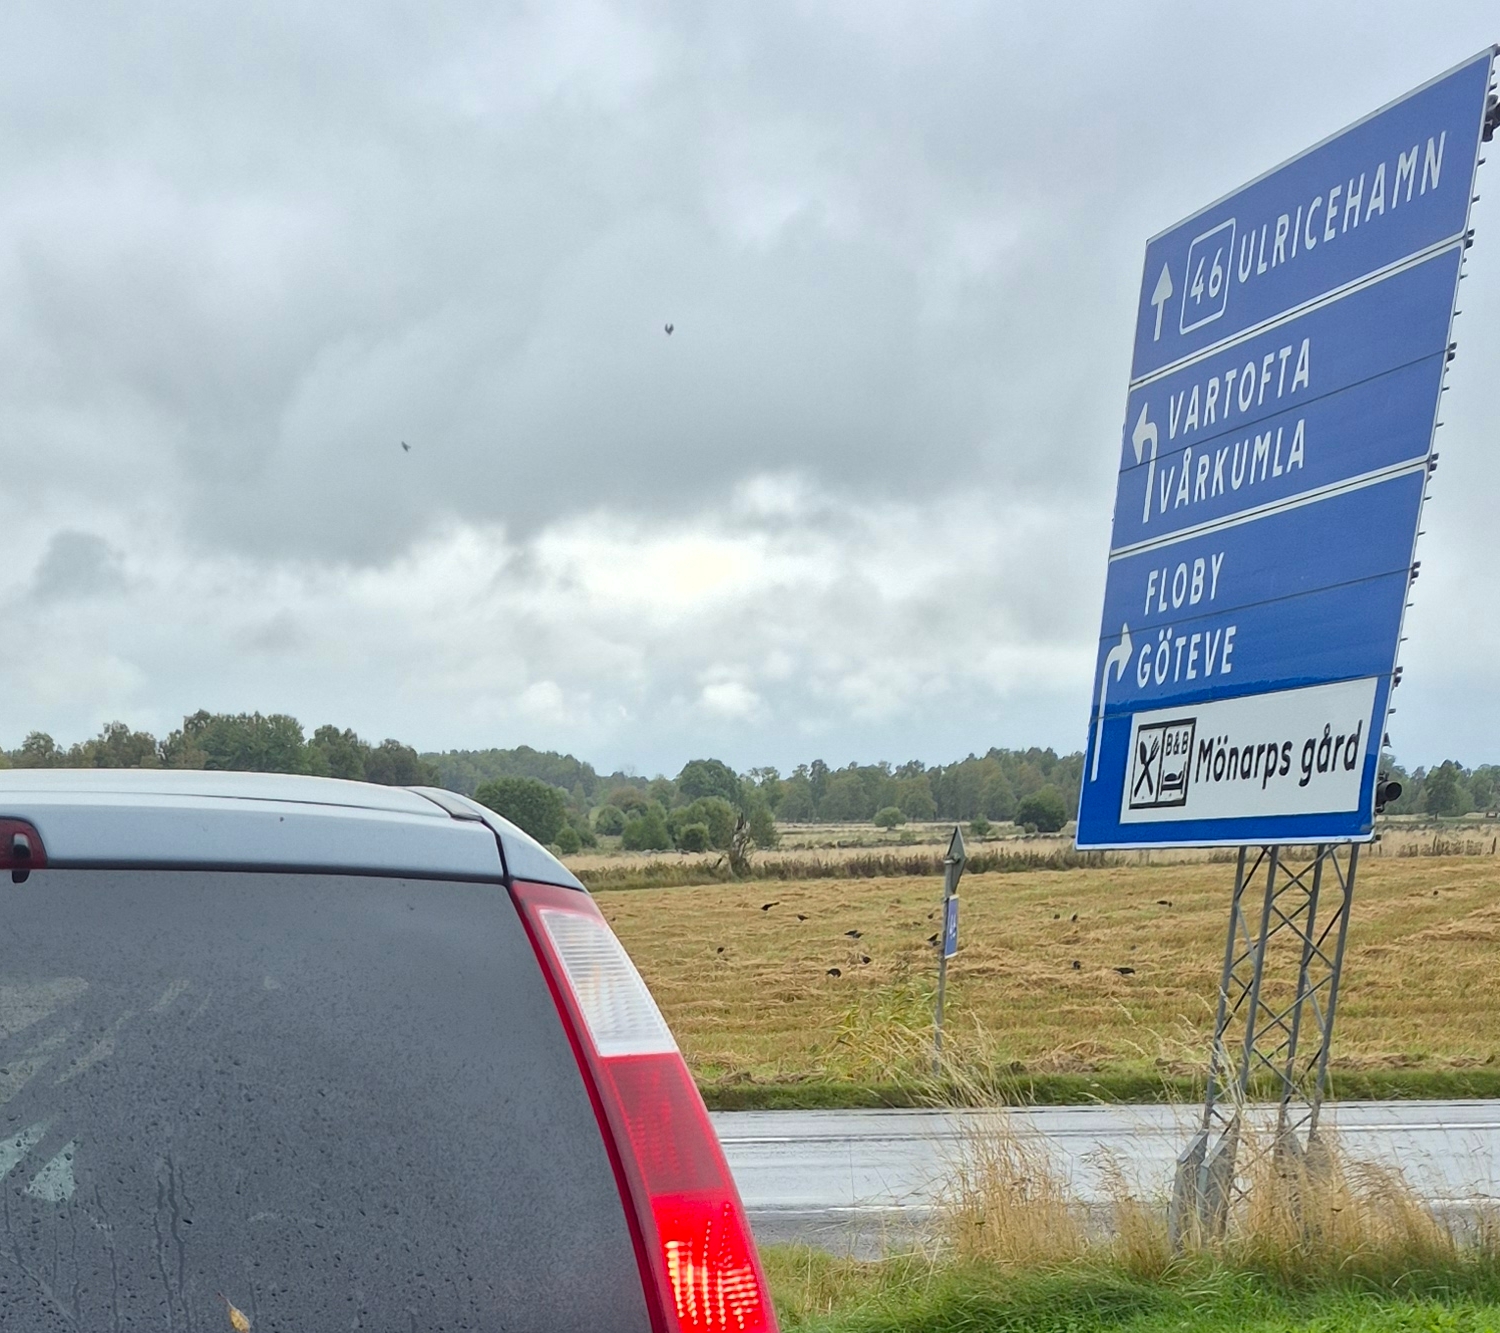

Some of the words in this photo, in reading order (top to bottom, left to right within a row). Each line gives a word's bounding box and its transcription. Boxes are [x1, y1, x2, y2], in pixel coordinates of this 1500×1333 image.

[1189, 246, 1223, 304] 46
[1237, 131, 1447, 283] ULRICEHAMN
[1168, 338, 1310, 440] VARTOFTA
[1159, 419, 1306, 514] VÅRKUMLA
[1144, 551, 1225, 616] FLOBY
[1136, 625, 1237, 688] GÖTEVE
[1165, 730, 1189, 756] B&B
[1195, 735, 1293, 790] Mönarps
[1298, 719, 1363, 788] gård
